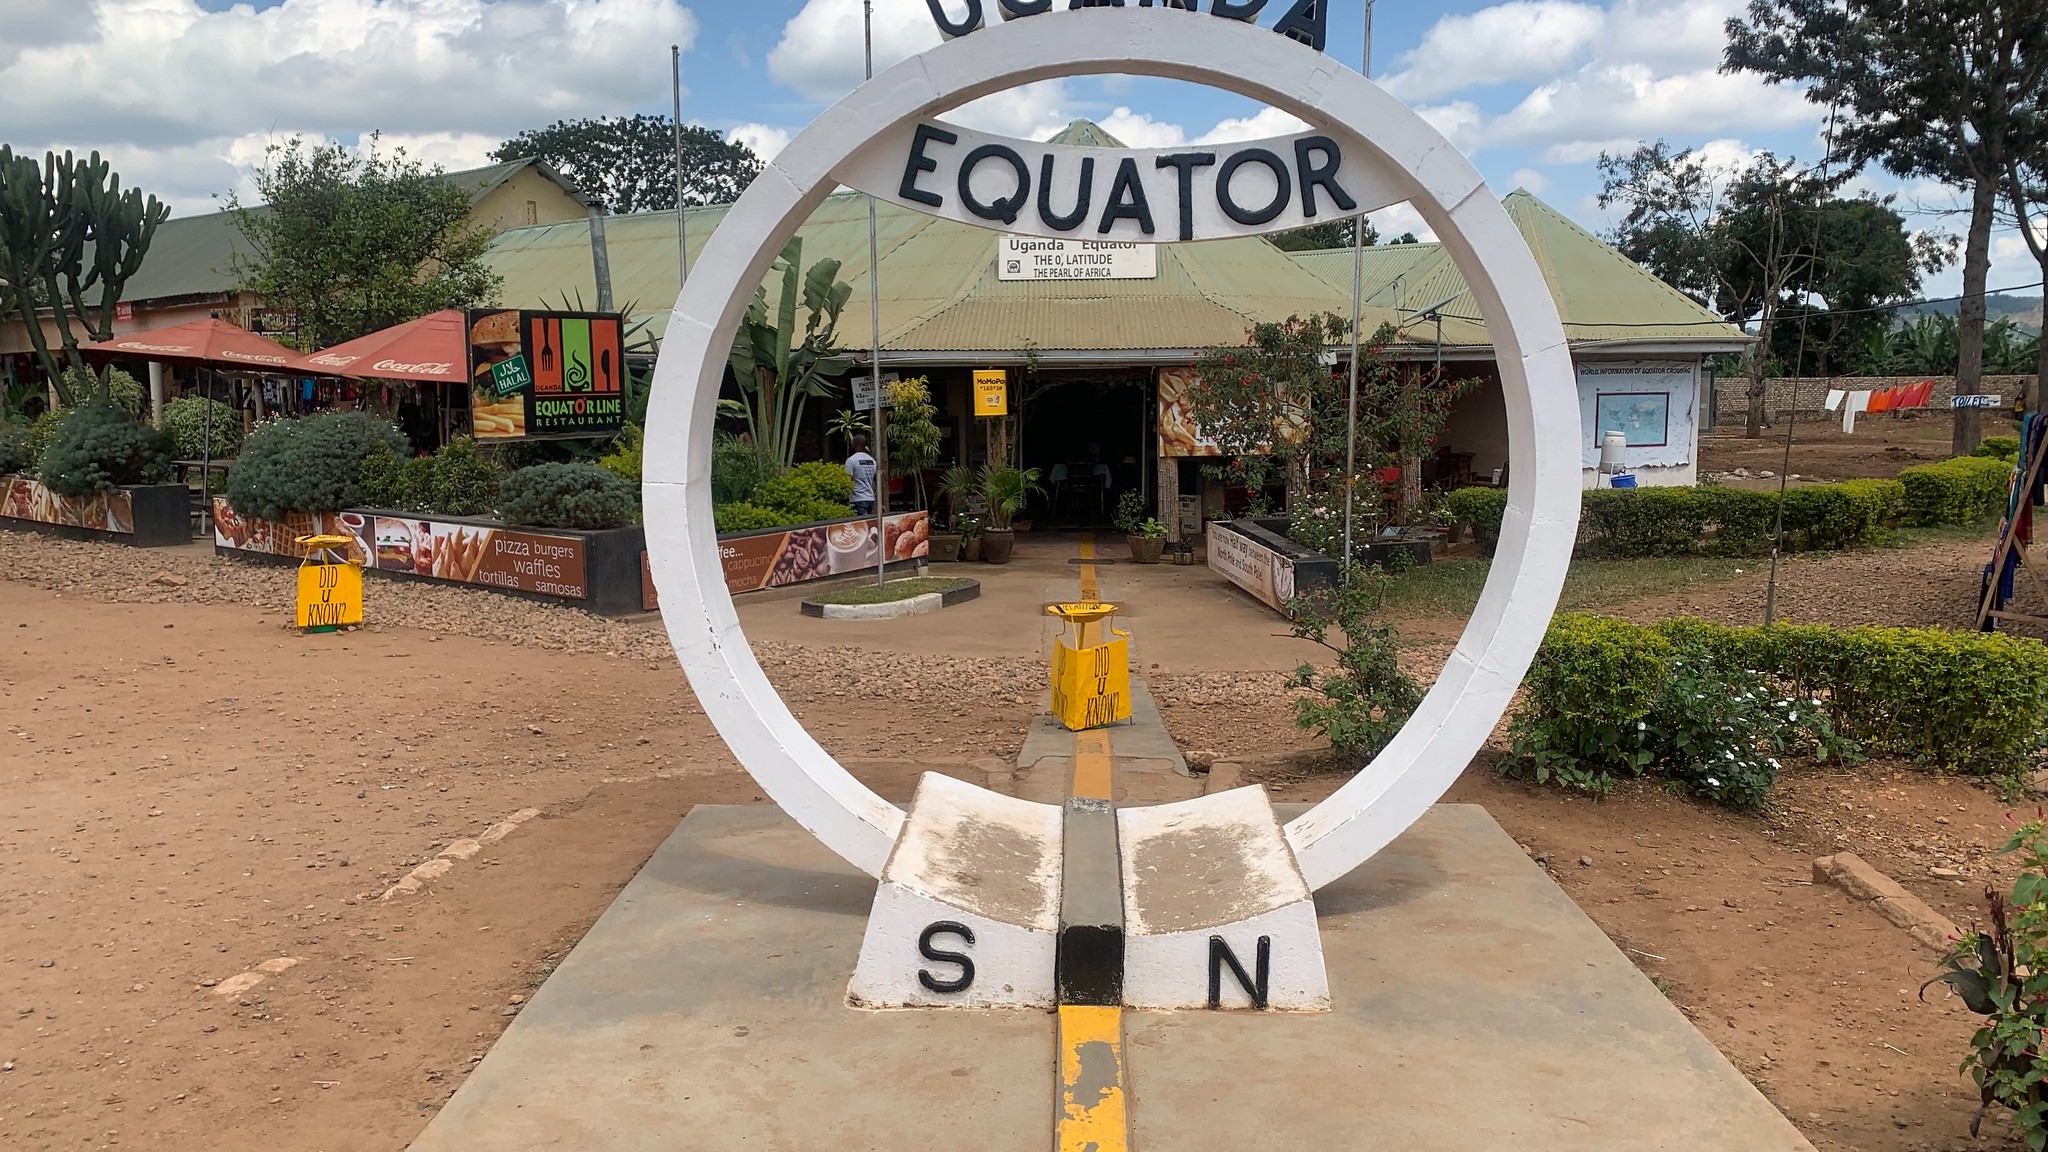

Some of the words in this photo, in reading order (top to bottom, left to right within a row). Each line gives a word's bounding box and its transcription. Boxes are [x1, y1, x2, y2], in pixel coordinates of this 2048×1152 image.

[898, 122, 1358, 242] EQUATOR
[1010, 239, 1064, 254] Uganda
[1034, 255, 1053, 266] THE
[1066, 254, 1112, 265] LATITUDE
[1033, 268, 1048, 278] THE
[1050, 268, 1072, 278] PEARL
[1074, 268, 1084, 277] OF
[1085, 267, 1111, 277] AFRICA
[372, 359, 453, 374] Coca-Cola
[499, 373, 528, 390] HALAL
[596, 399, 621, 414] LINE
[536, 415, 621, 427] RESTAURANT
[494, 536, 530, 556] pizza
[533, 540, 574, 559] burgers
[513, 558, 561, 579] waffles
[727, 554, 773, 571] cappucino
[319, 566, 338, 588] DID
[479, 569, 519, 588] tortillas
[535, 580, 582, 597] samosas
[728, 574, 757, 587] mocha
[307, 602, 347, 627] KNOW?
[1094, 646, 1110, 678] DID
[1085, 691, 1120, 727] KNOW?
[917, 919, 976, 993] S
[1208, 934, 1271, 1010] N
